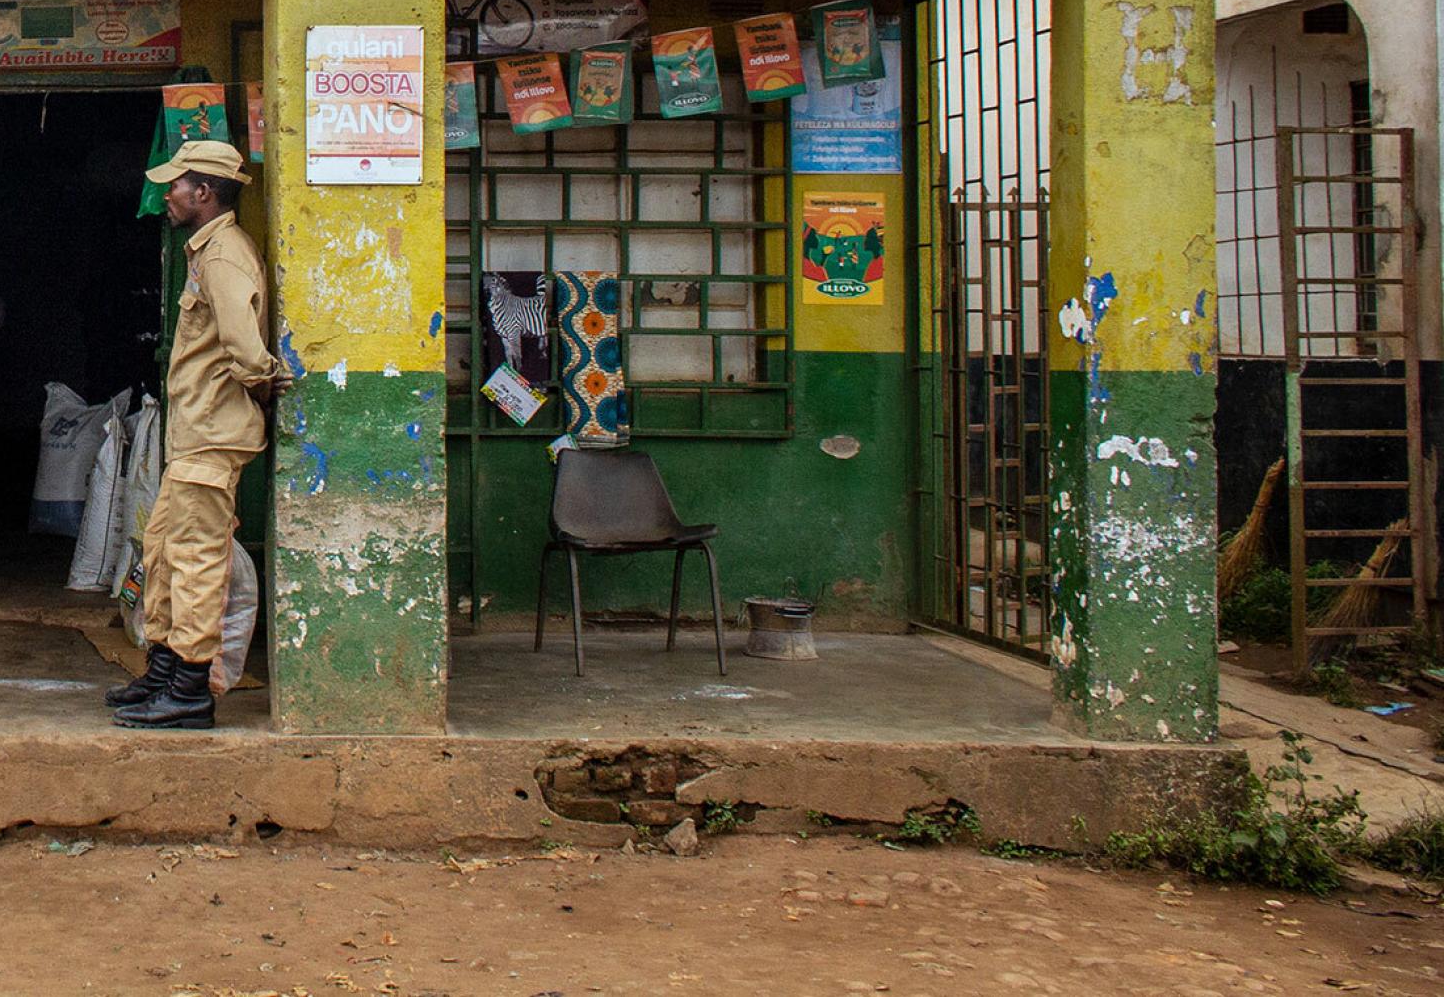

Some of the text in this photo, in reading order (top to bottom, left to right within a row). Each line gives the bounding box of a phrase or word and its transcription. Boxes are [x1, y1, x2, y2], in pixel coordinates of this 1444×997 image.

[327, 34, 404, 60] gulani
[0, 51, 94, 65] Available
[315, 74, 413, 94] BOOSTA
[674, 96, 709, 108] ILLOVO
[316, 104, 413, 134] PANO
[822, 284, 867, 293] ILLOVO
